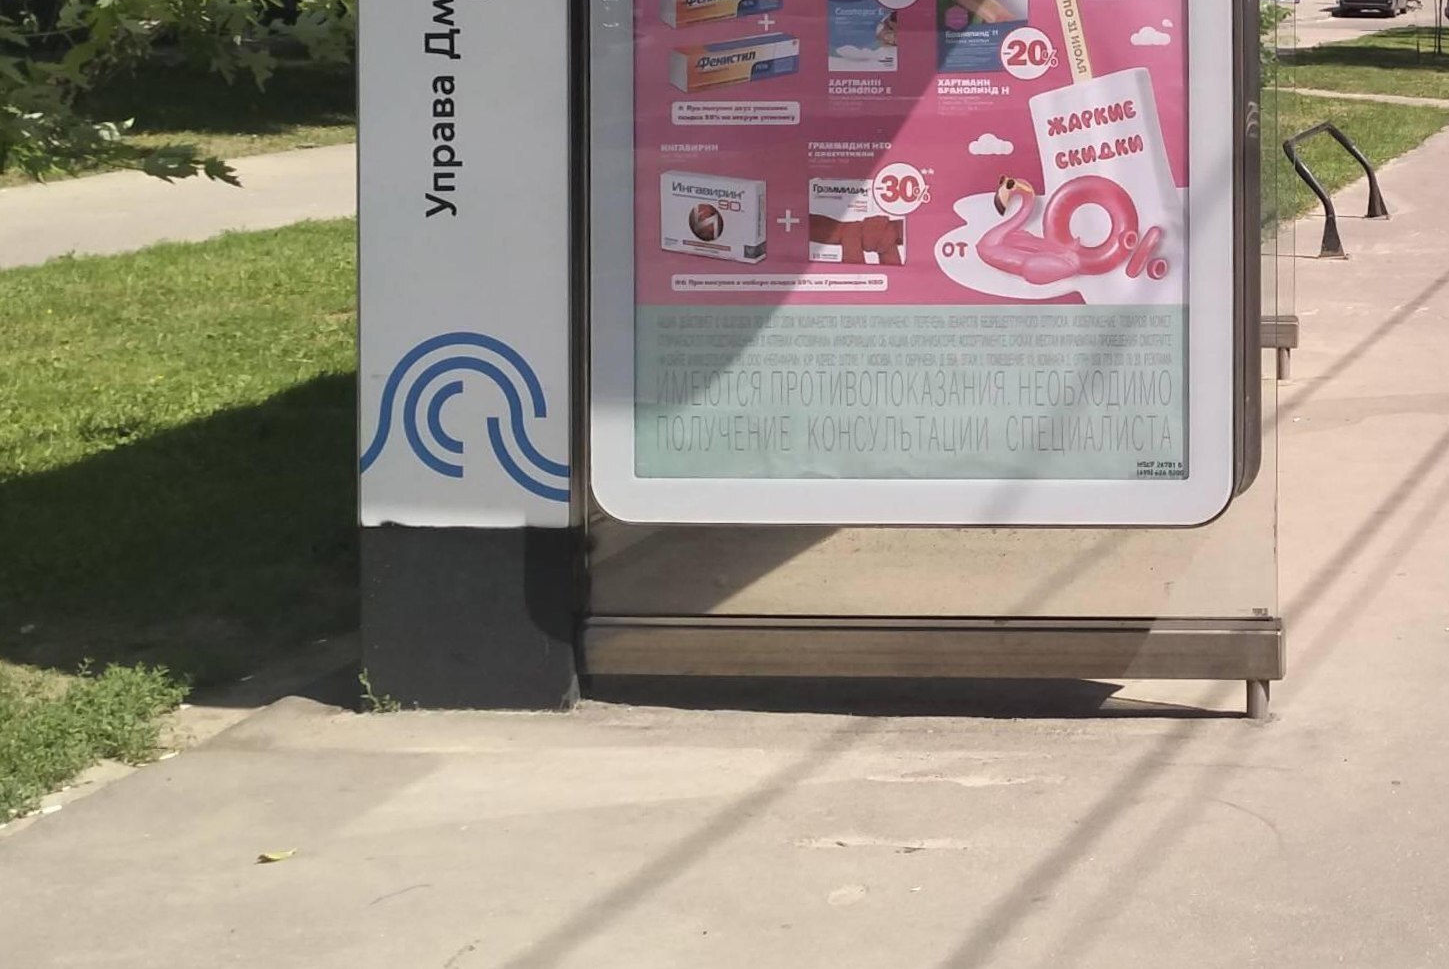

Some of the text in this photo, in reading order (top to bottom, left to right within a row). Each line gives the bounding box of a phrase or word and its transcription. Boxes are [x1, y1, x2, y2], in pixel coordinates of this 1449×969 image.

[697, 50, 756, 70] Фенистил
[1071, 35, 1087, 74] ИЮЛЯ
[937, 79, 991, 87] ХАРТМАНН
[1047, 99, 1137, 137] ЖАРКИЕ
[424, 76, 463, 219] Управа
[1055, 134, 1144, 170] СКИДКИ
[672, 181, 742, 200] Ингавирин
[718, 199, 741, 212] 90
[656, 369, 1172, 410] ИМЕЮТСЯ ПРОТИВОПОКАЗАНИЯ. НЕОБХОДИМО
[656, 415, 1172, 456] ПОЛУЧЕНИЕ КОНСУЛЬТАЦИИ СПЕЦИАЛИСТА
